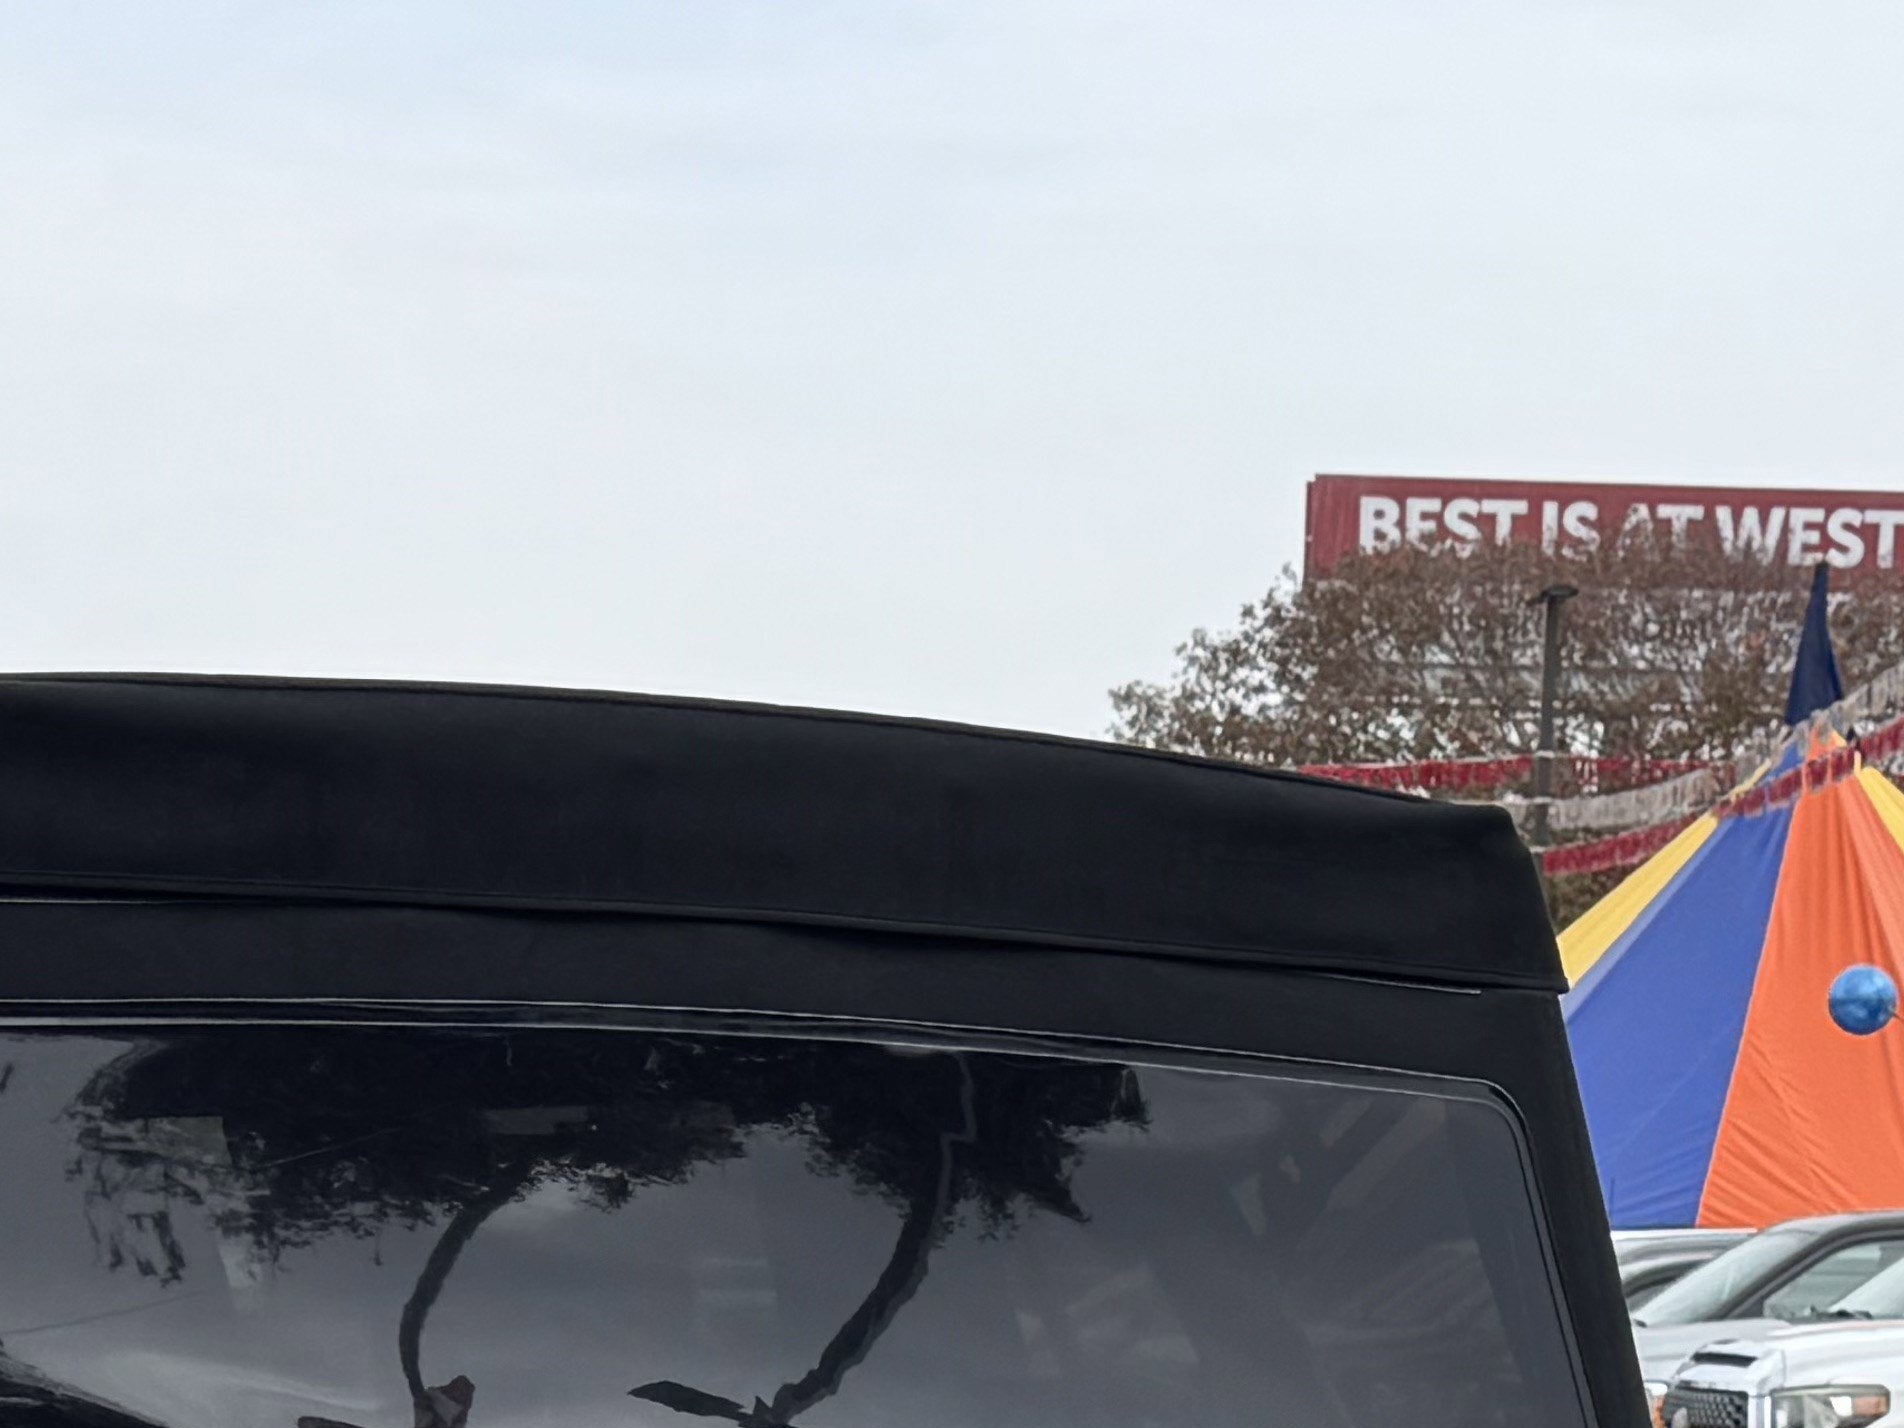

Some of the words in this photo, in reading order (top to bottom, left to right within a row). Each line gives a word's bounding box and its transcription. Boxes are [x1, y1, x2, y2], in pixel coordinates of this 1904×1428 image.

[1359, 495, 1529, 559] BEST
[1542, 499, 1601, 562] IS
[1617, 502, 1705, 562] AT
